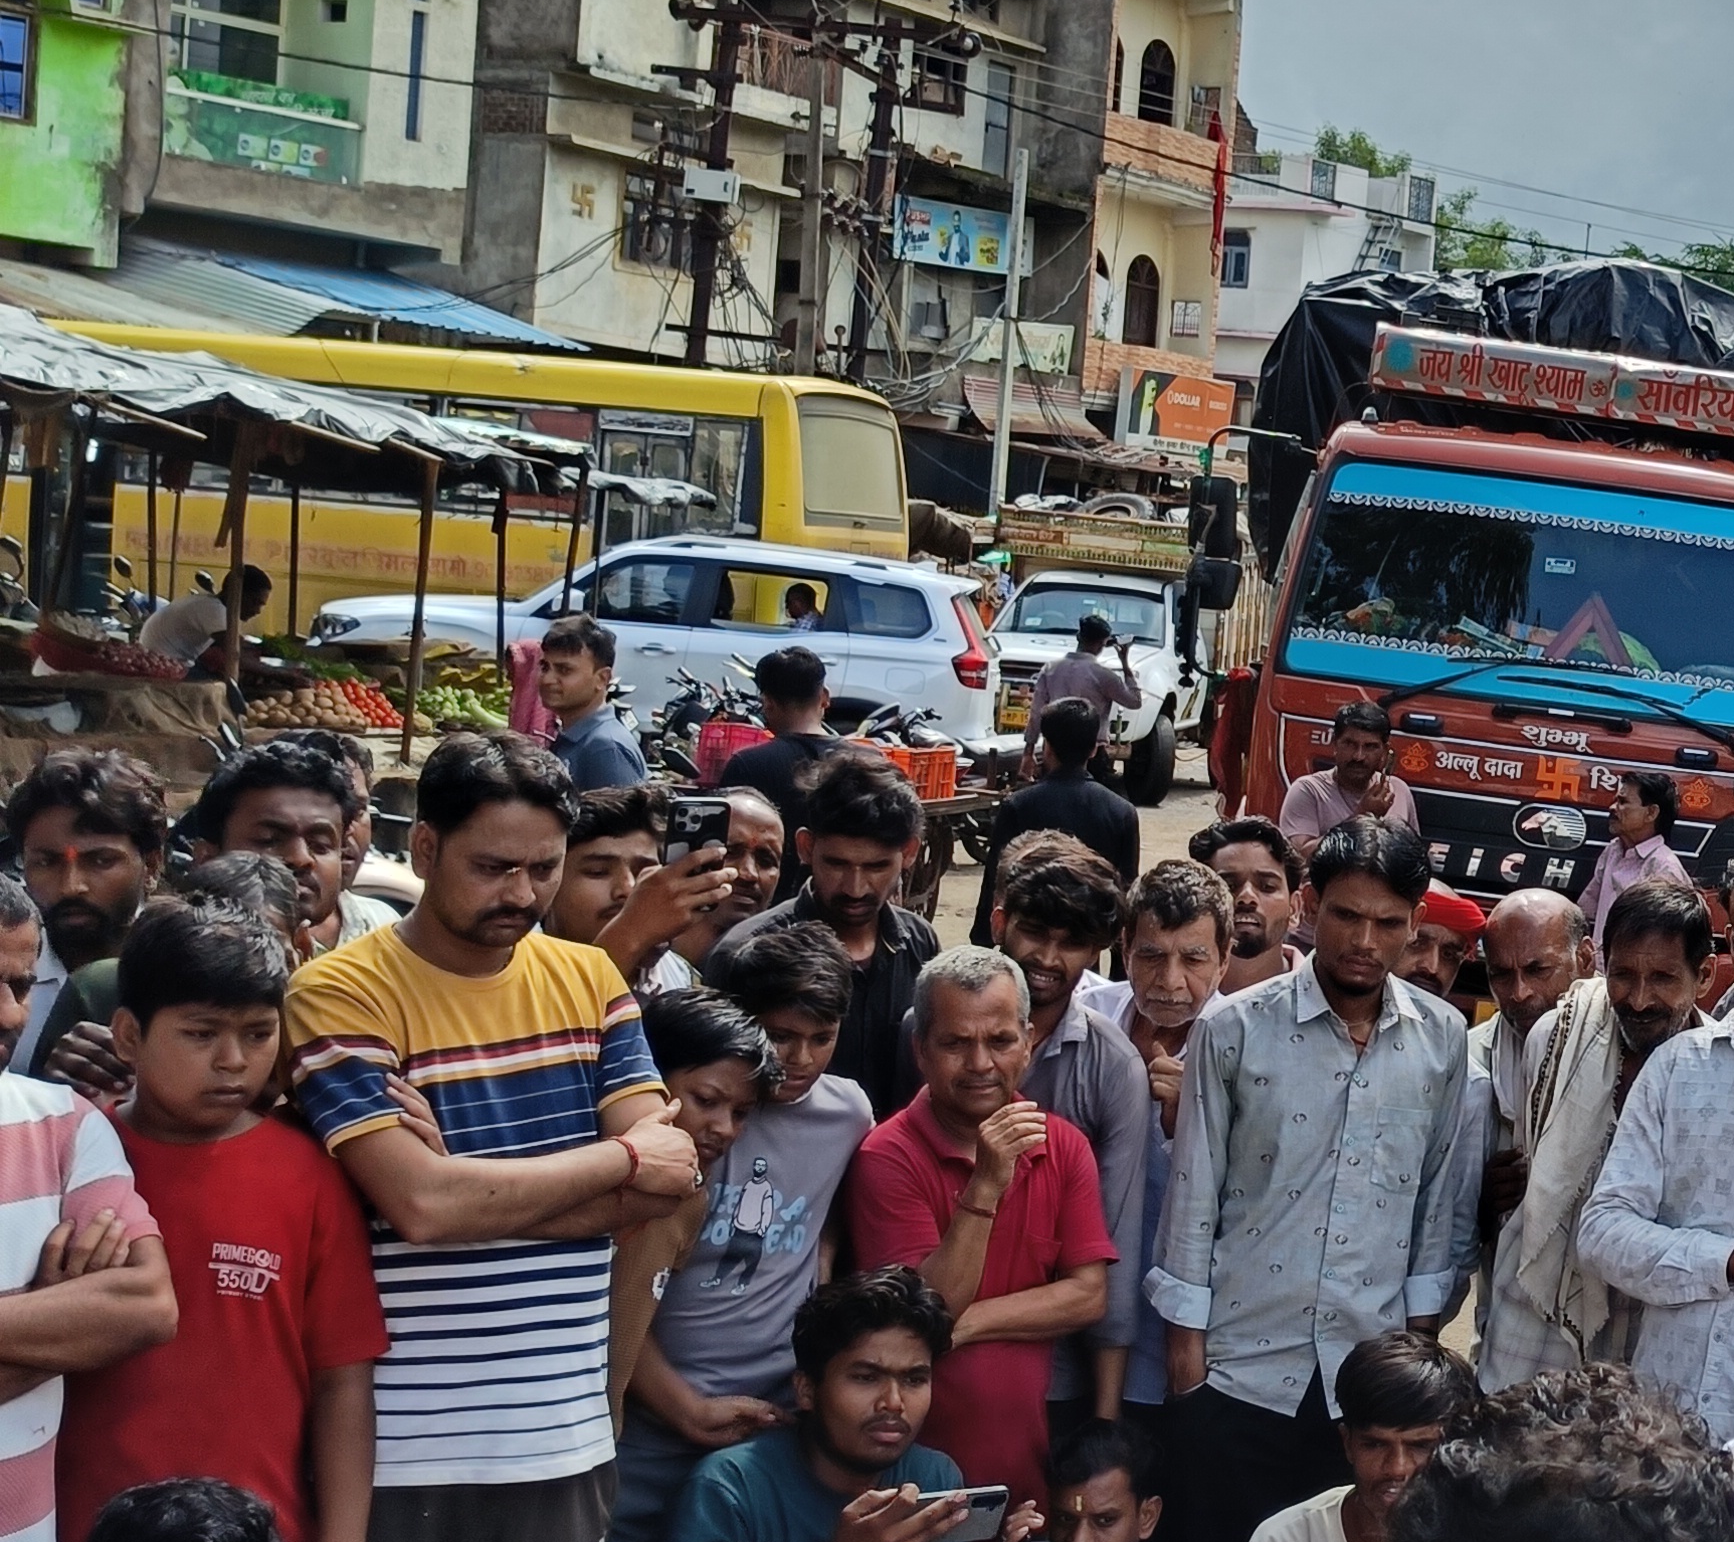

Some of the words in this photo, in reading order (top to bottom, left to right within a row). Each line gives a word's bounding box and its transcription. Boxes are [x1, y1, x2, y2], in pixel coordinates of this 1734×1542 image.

[1419, 348, 1454, 383] जय
[1457, 343, 1485, 387] श्री
[1487, 356, 1532, 406] खाटू
[1534, 363, 1587, 401] श्याम
[1484, 754, 1524, 780] दादा
[1428, 842, 1576, 889] EICH
[216, 1267, 272, 1294] 550D
